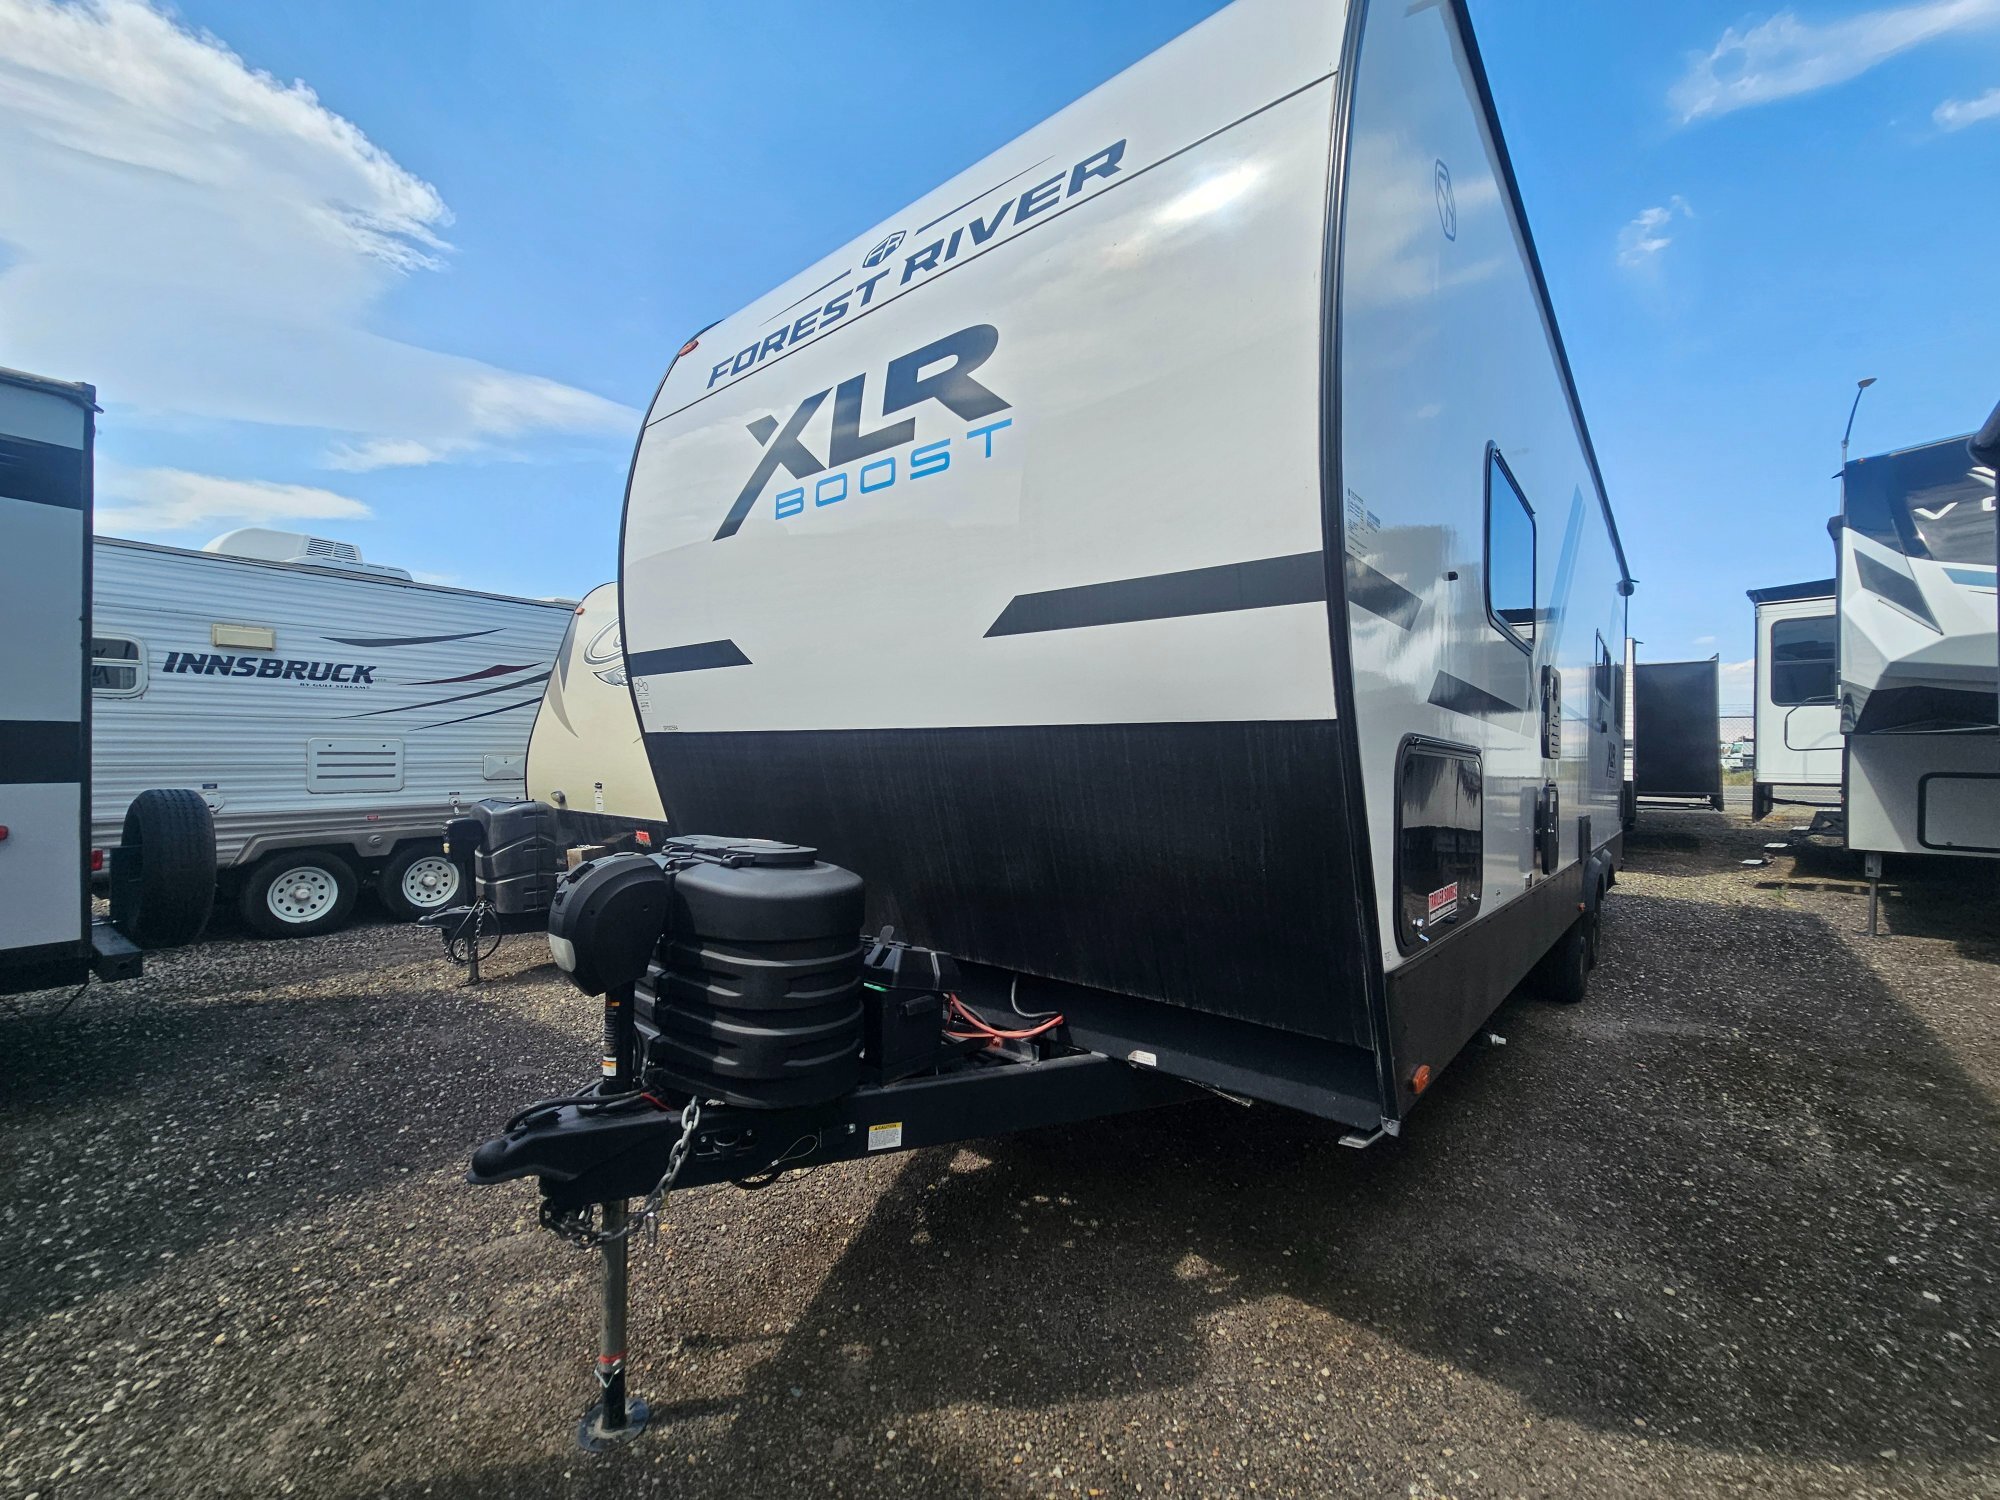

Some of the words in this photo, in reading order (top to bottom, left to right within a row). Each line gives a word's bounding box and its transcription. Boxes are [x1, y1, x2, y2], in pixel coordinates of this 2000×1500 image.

[706, 267, 891, 389] FOREST
[900, 138, 1127, 286] RIVER
[712, 323, 1013, 542] XLR
[775, 418, 1012, 521] BOOST
[162, 651, 377, 684] INNSBRUCK
